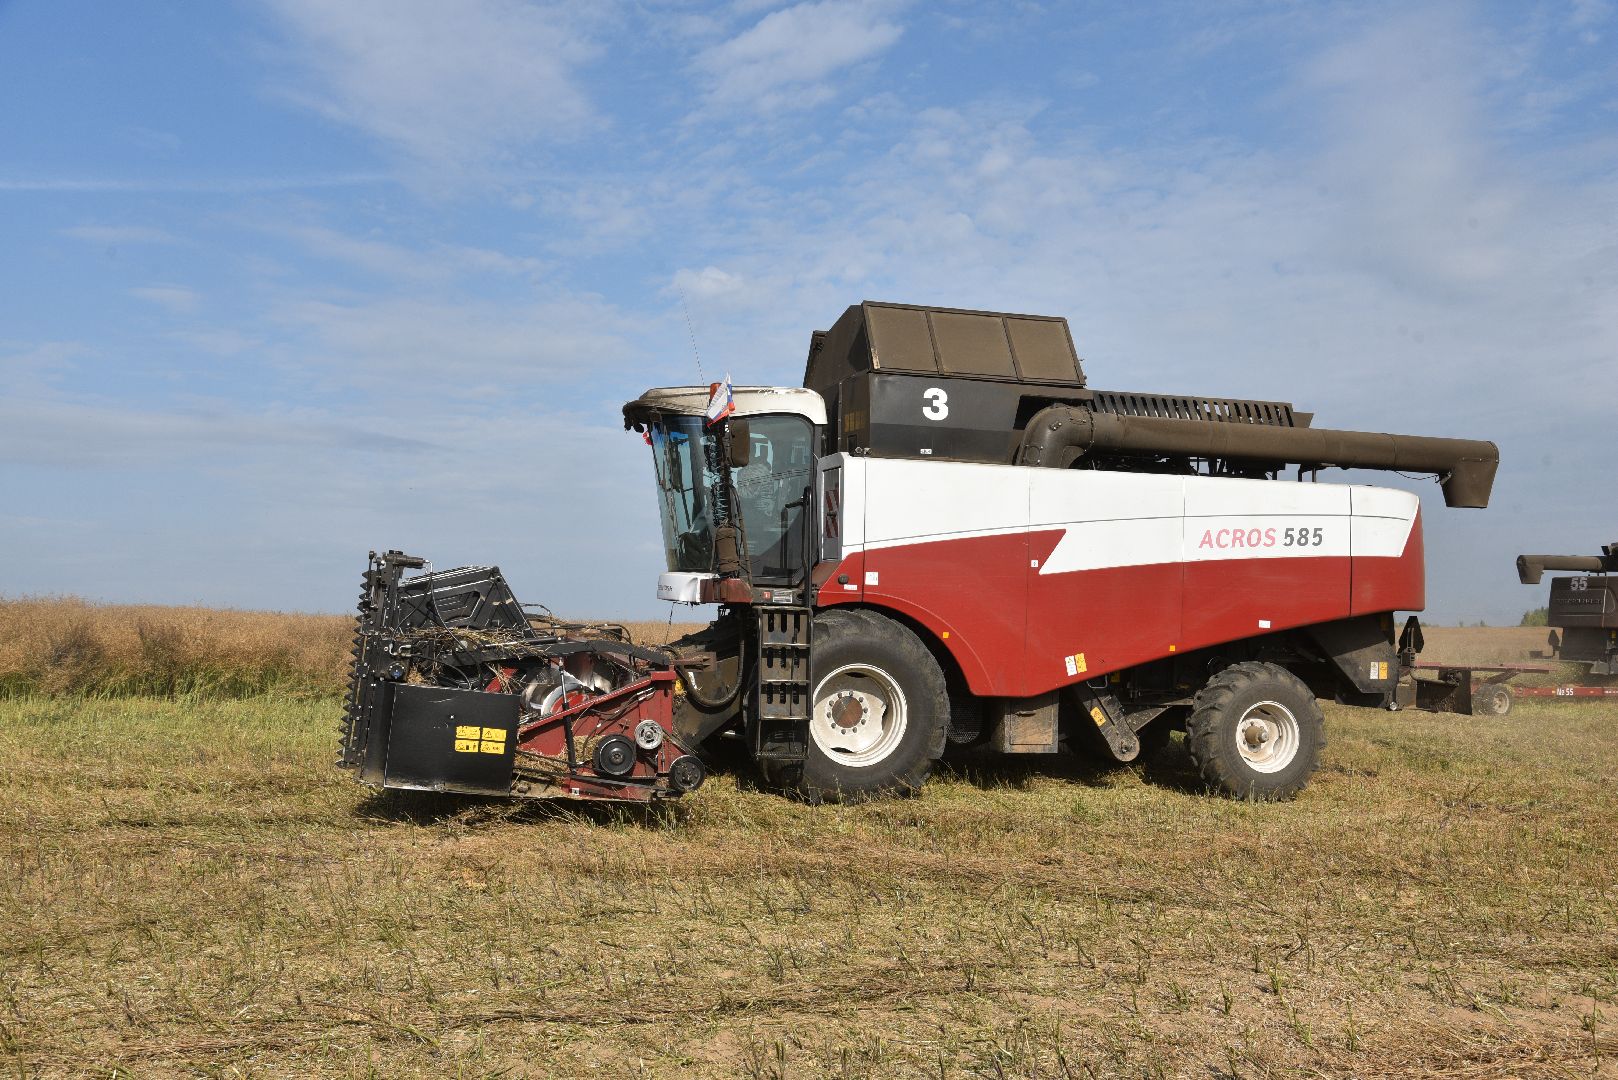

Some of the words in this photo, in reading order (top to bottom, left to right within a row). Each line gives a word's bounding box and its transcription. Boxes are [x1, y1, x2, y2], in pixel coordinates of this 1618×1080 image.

[923, 387, 949, 420] 3
[1199, 528, 1277, 548] ACROS
[1282, 527, 1323, 547] 585
[1570, 576, 1588, 591] 55
